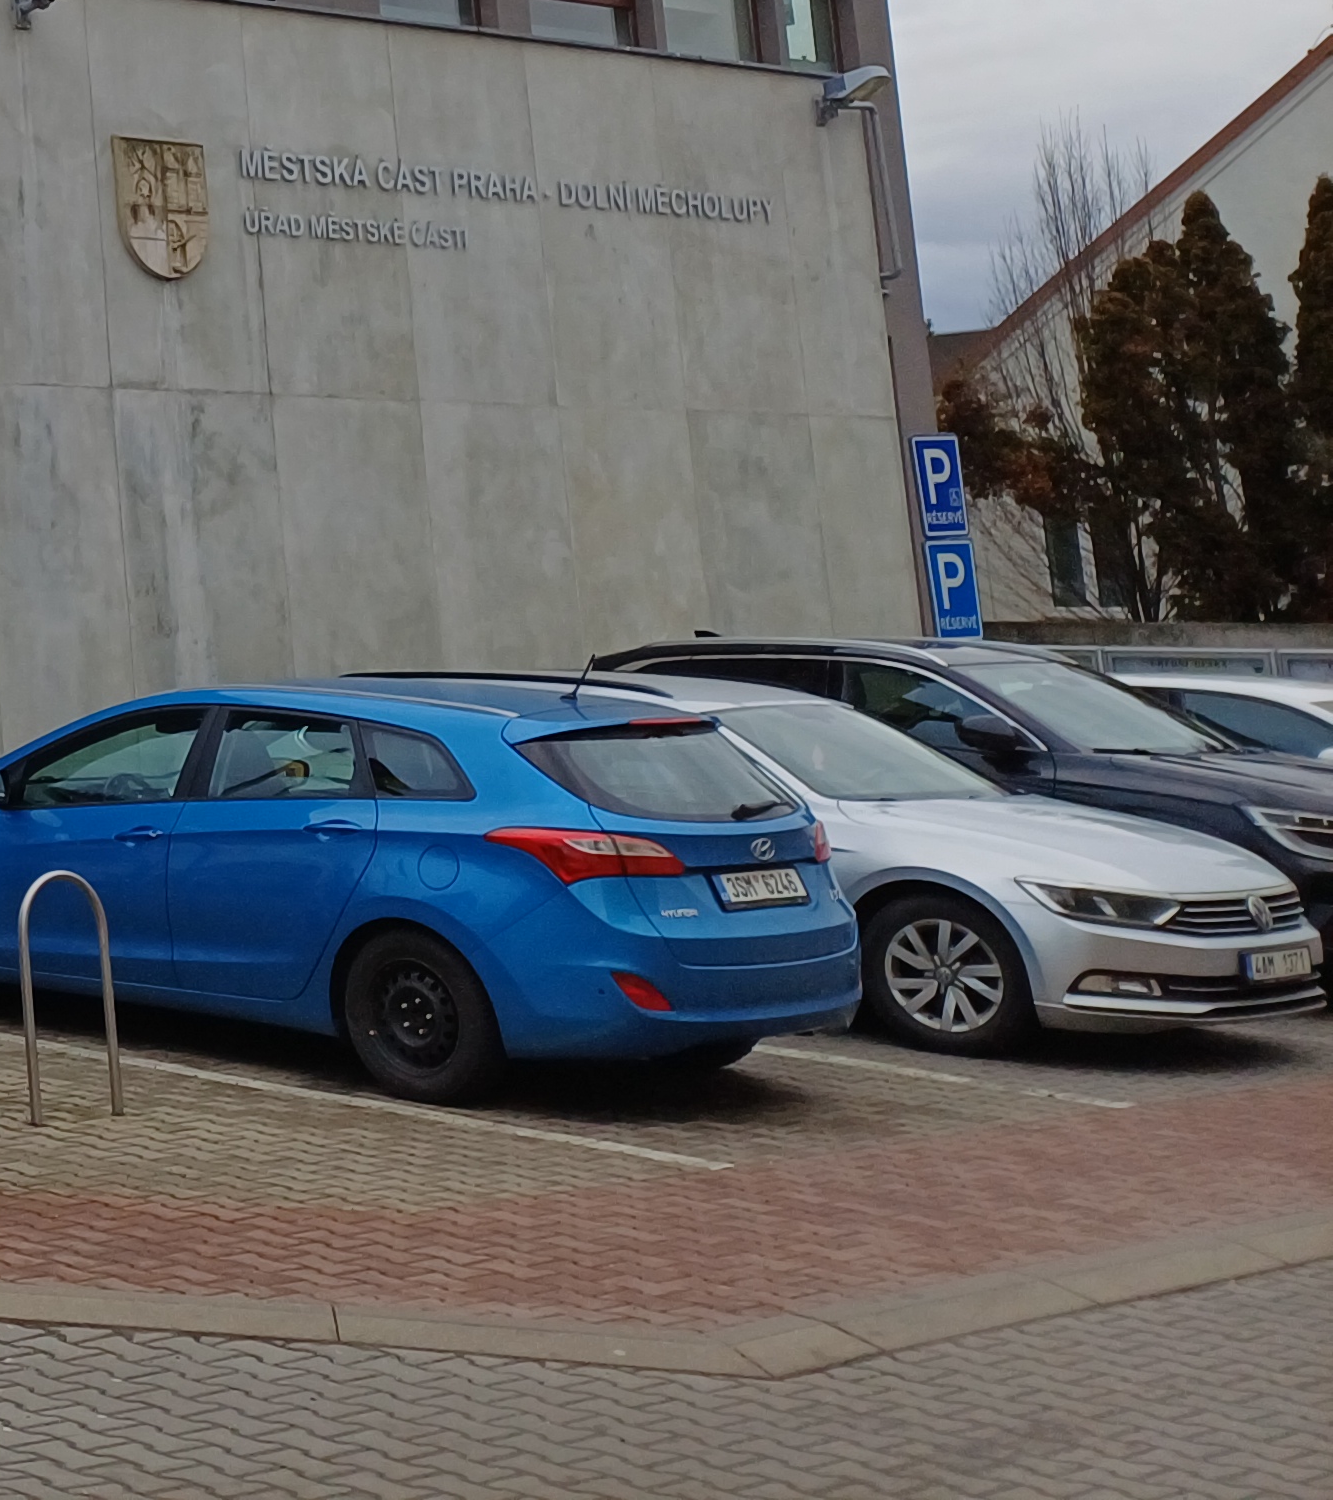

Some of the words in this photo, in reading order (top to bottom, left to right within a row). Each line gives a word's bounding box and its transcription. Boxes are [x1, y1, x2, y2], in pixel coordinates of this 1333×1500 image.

[240, 144, 371, 187] MĚSTSKÁ
[377, 157, 443, 195] ČÁST
[452, 167, 538, 202] PRAHA
[557, 178, 632, 212] DOLNÍ
[635, 183, 774, 225] MĚCHOLUPY
[244, 206, 305, 237] ÚŘAD
[310, 211, 406, 245] MĚSTSKÉ
[411, 219, 469, 249] ČÁSTI
[923, 448, 951, 504] P
[927, 509, 965, 525] RÉSERVÉ
[936, 553, 965, 610] P
[940, 614, 978, 631] RÉSERVÉ
[726, 875, 758, 899] 3SM
[761, 872, 800, 896] 6246
